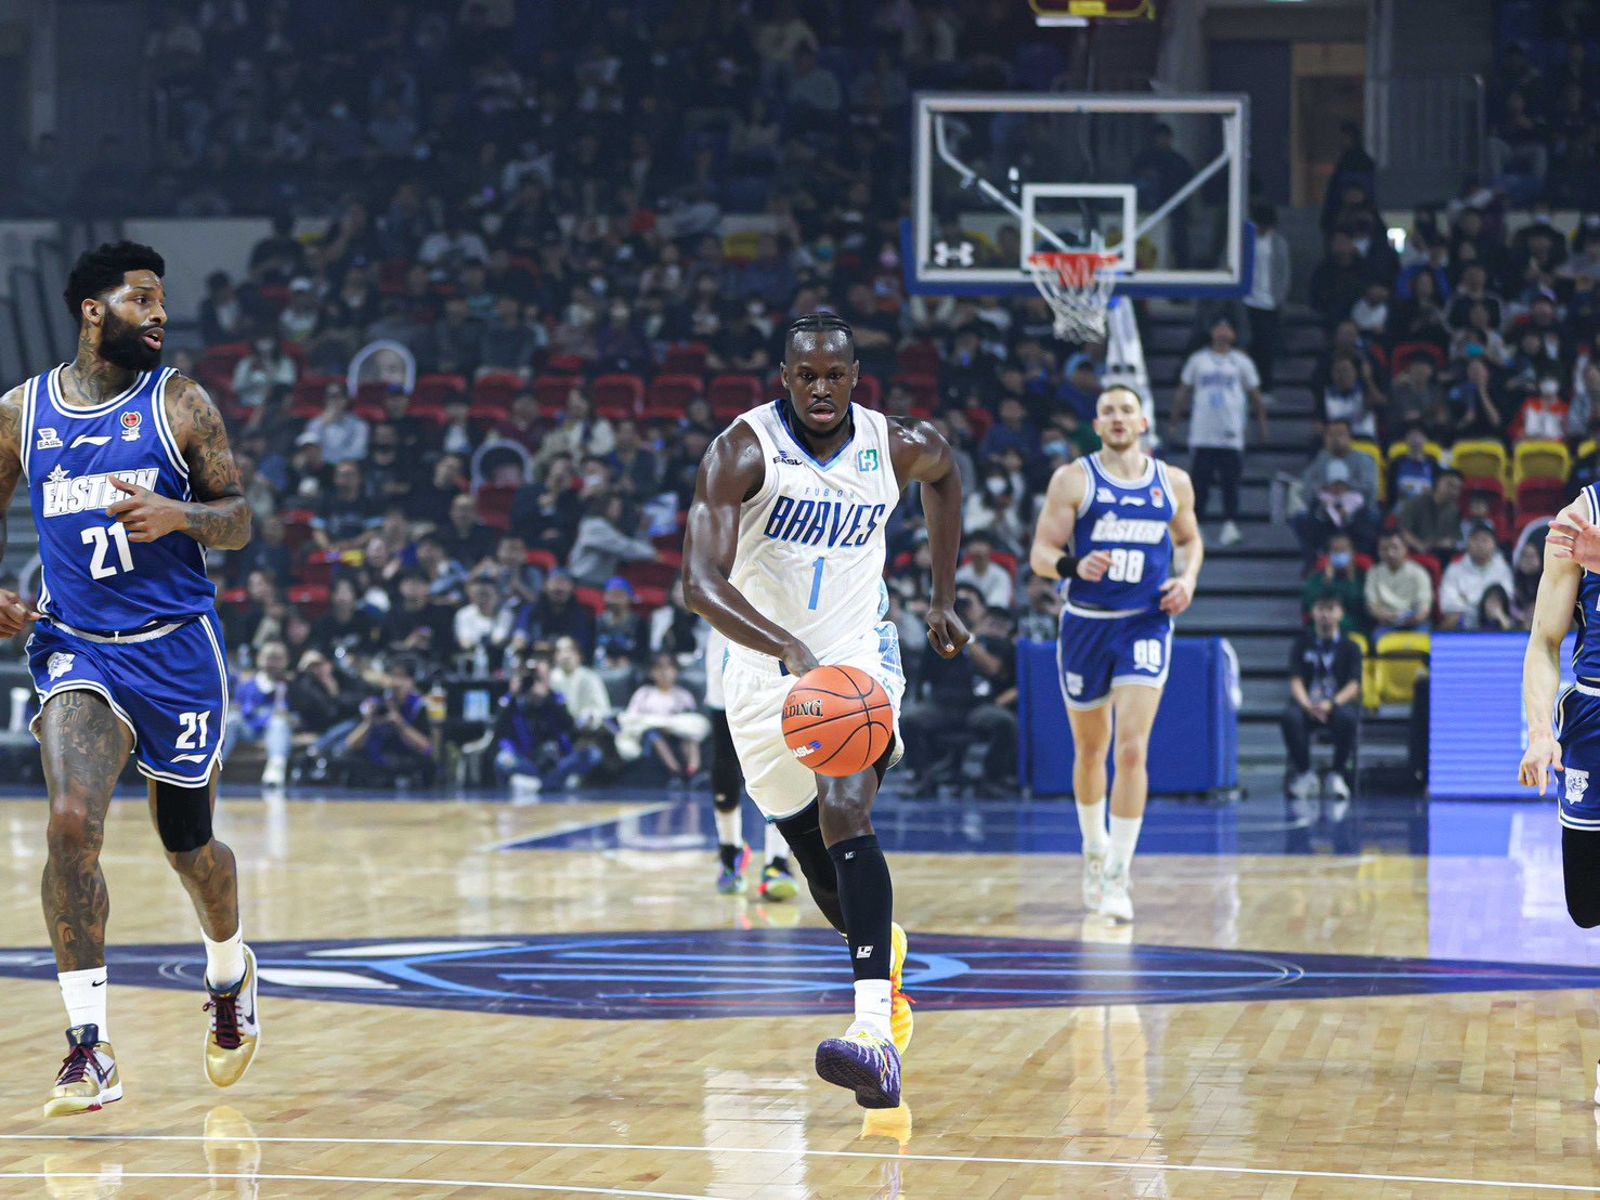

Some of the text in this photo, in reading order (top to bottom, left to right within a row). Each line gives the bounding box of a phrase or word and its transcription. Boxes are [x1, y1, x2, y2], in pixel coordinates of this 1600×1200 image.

[773, 455, 803, 466] EASL
[764, 495, 886, 549] BRAVES
[81, 521, 135, 580] 21
[808, 556, 825, 611] 1
[175, 710, 211, 749] 21
